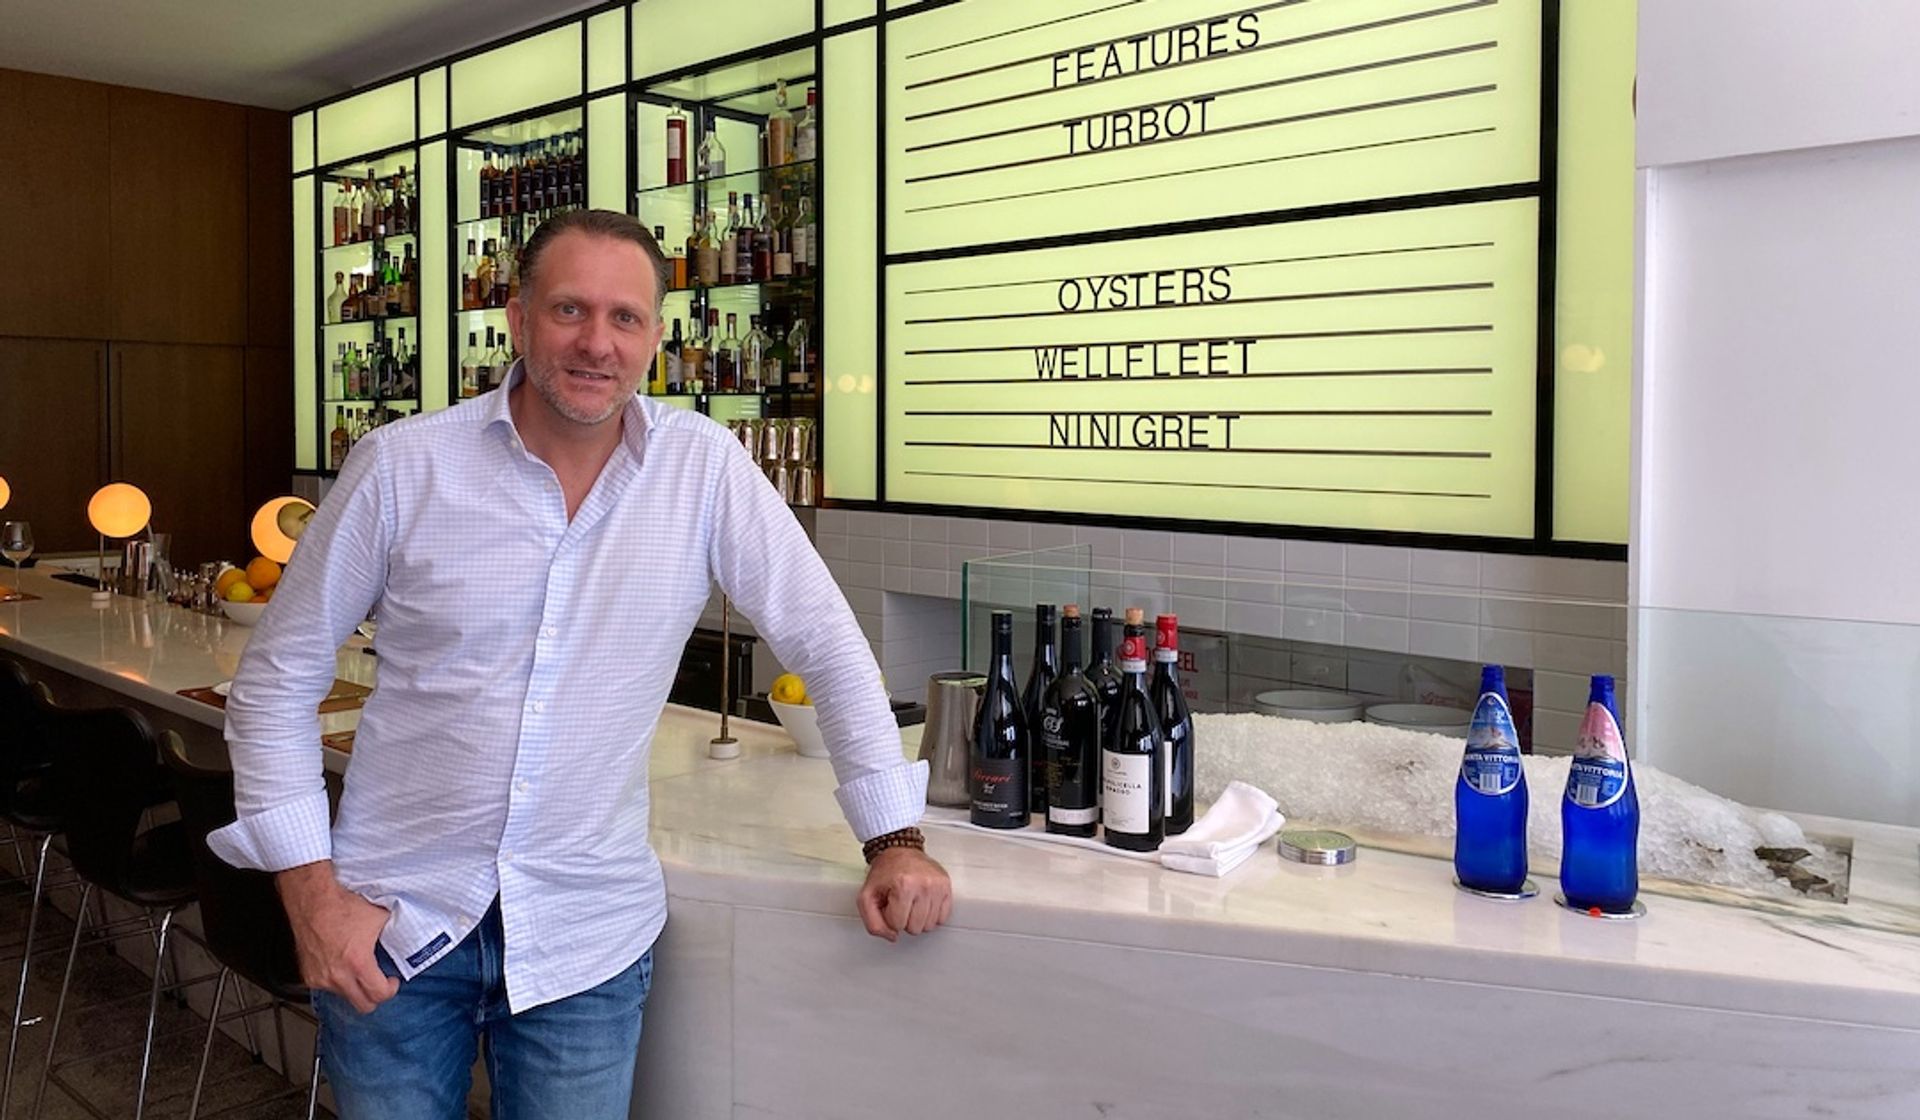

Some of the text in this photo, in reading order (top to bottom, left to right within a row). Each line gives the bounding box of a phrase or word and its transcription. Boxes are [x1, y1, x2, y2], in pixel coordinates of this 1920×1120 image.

[1053, 13, 1260, 88] FEATURES
[1063, 97, 1216, 155] TURBOT
[1058, 267, 1232, 311] OYSTERS
[1034, 340, 1257, 379] WELLFLEET
